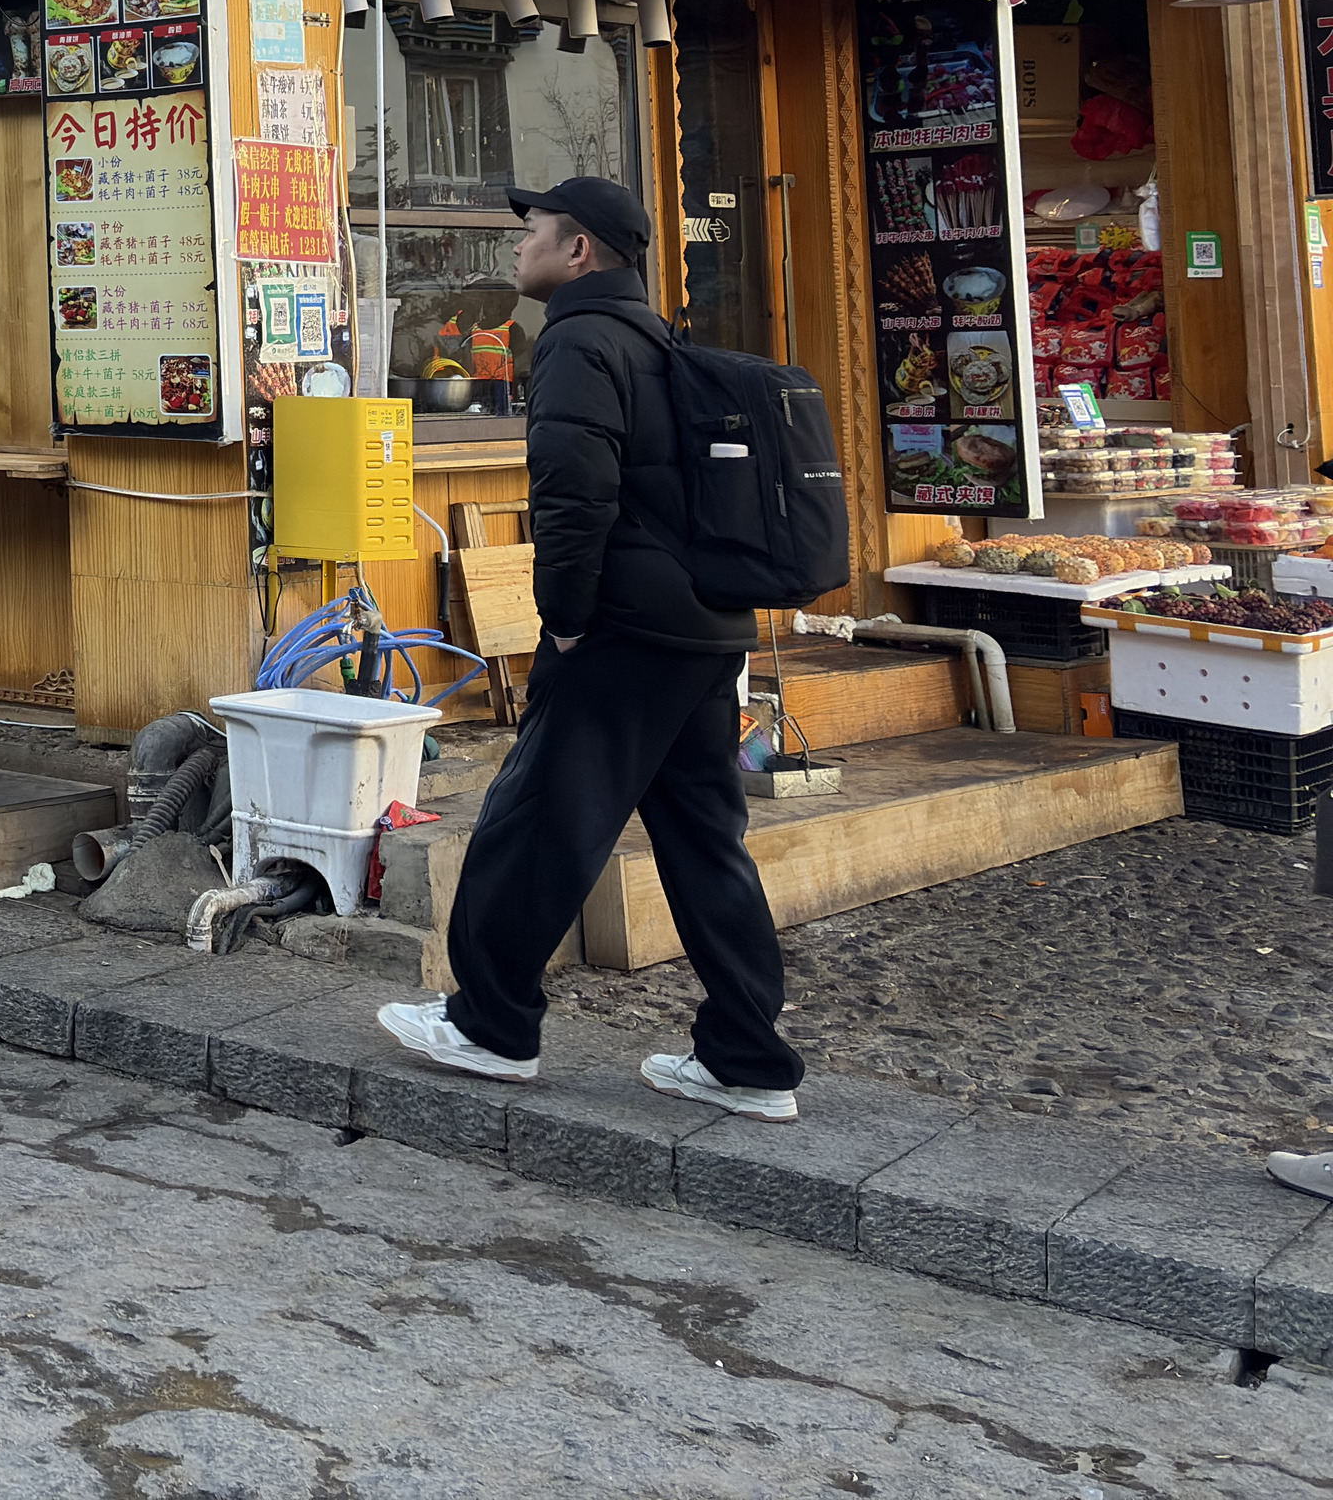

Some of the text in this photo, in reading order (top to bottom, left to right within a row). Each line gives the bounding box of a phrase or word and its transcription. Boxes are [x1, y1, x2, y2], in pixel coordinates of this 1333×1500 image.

[51, 103, 204, 153] 今日特价
[874, 123, 992, 148] 本地牦牛肉串
[98, 156, 122, 168] 小份
[98, 167, 203, 185] 藏香猪+菌子 38元
[98, 183, 203, 201] 牦牛肉+菌子 48元
[241, 172, 280, 200] 牛肉大串
[240, 201, 280, 229] 假一赔十
[101, 221, 124, 234] 中份
[100, 234, 205, 250] 藏香猪+菌子 48元
[100, 251, 206, 267] 牦牛肉+菌子 58元
[102, 285, 126, 298] 大份
[102, 300, 208, 314] 藏香猪+菌子 58元
[102, 317, 209, 330] 牦牛肉+菌子 68元
[61, 349, 121, 362] 情侣款三拼
[61, 367, 157, 381] 猪+牛+菌子 58元
[63, 385, 123, 399] 家庭款三拼
[63, 405, 158, 419] 猪+牛+菌子 68元
[915, 486, 996, 505] 藏式夹馍
